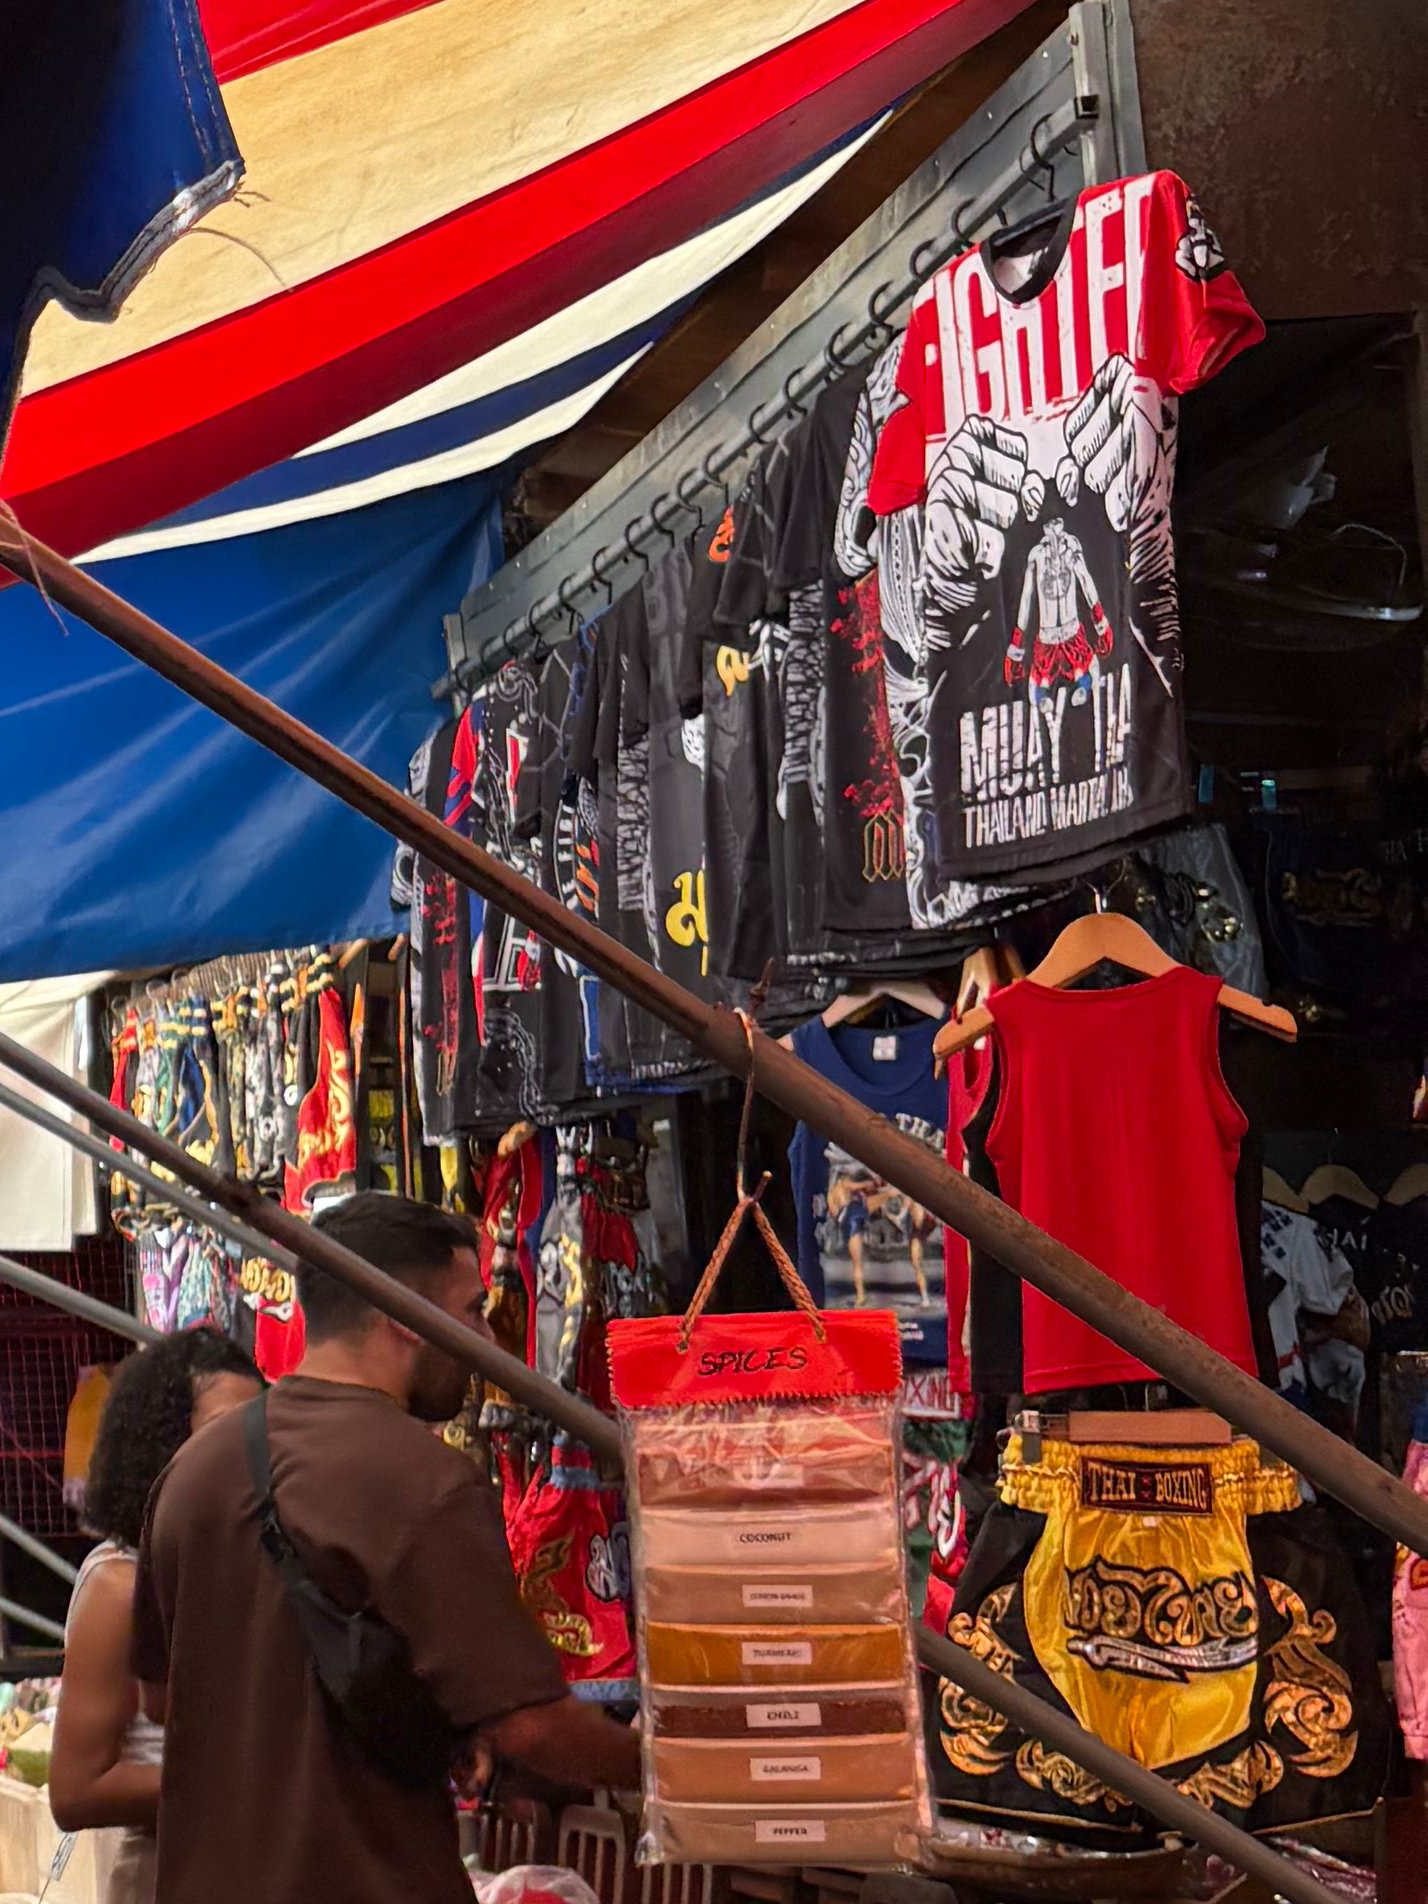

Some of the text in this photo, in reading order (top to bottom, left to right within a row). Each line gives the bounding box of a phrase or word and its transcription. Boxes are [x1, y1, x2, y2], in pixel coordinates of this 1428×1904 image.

[960, 678, 1066, 800] MUAY
[962, 792, 1048, 848] THAILAND
[697, 1346, 809, 1377] SPICES
[1087, 1462, 1208, 1510] THAI BOXING
[739, 1532, 793, 1544] COCONUT
